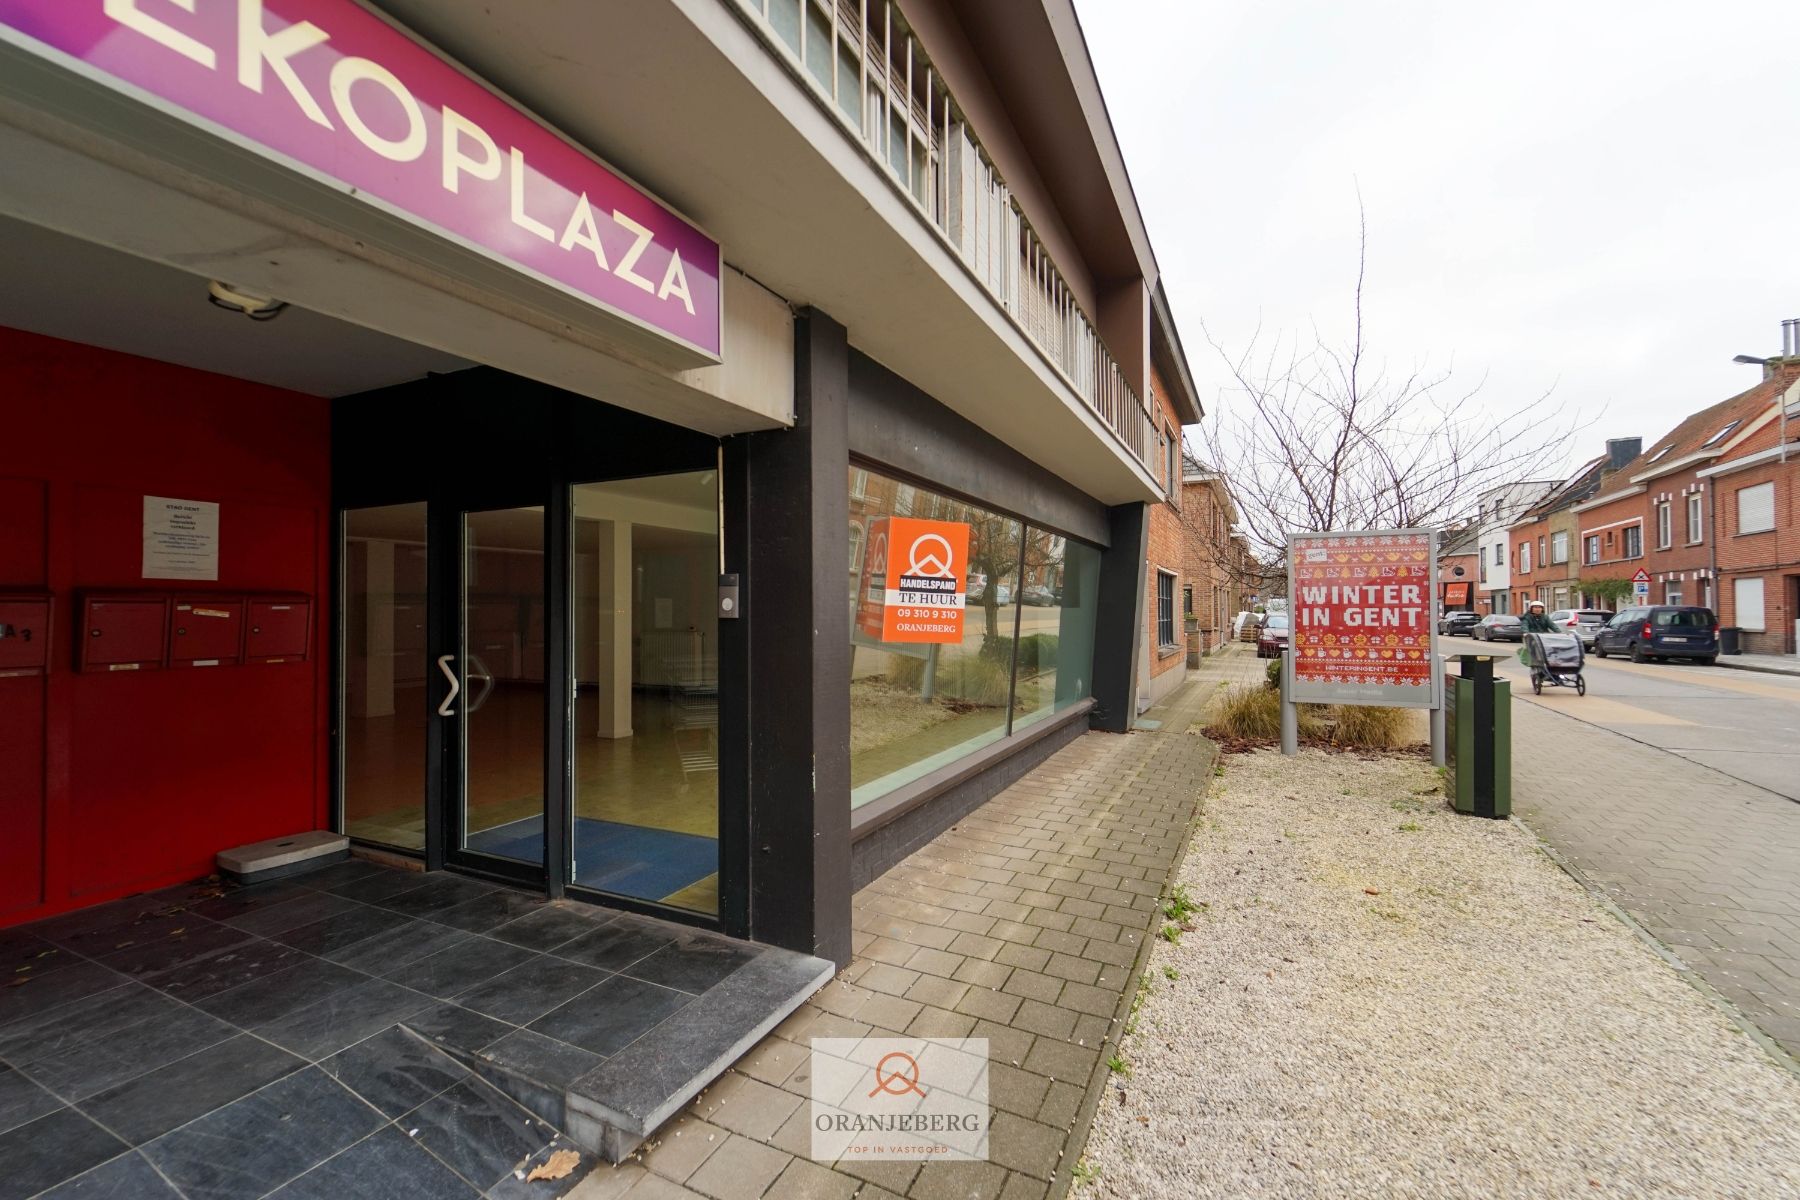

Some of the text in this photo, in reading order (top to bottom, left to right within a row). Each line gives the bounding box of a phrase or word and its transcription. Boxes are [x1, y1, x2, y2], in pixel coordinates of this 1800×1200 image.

[900, 578, 955, 590] HANDELSPAND
[899, 592, 957, 605] TE HUUR
[1302, 585, 1421, 604] WINTER
[897, 609, 956, 619] 09 310 9 310
[1302, 607, 1422, 627] IN GENT
[897, 623, 955, 632] ORANJEBERG
[1325, 665, 1399, 673] WINTERINGENT.BE
